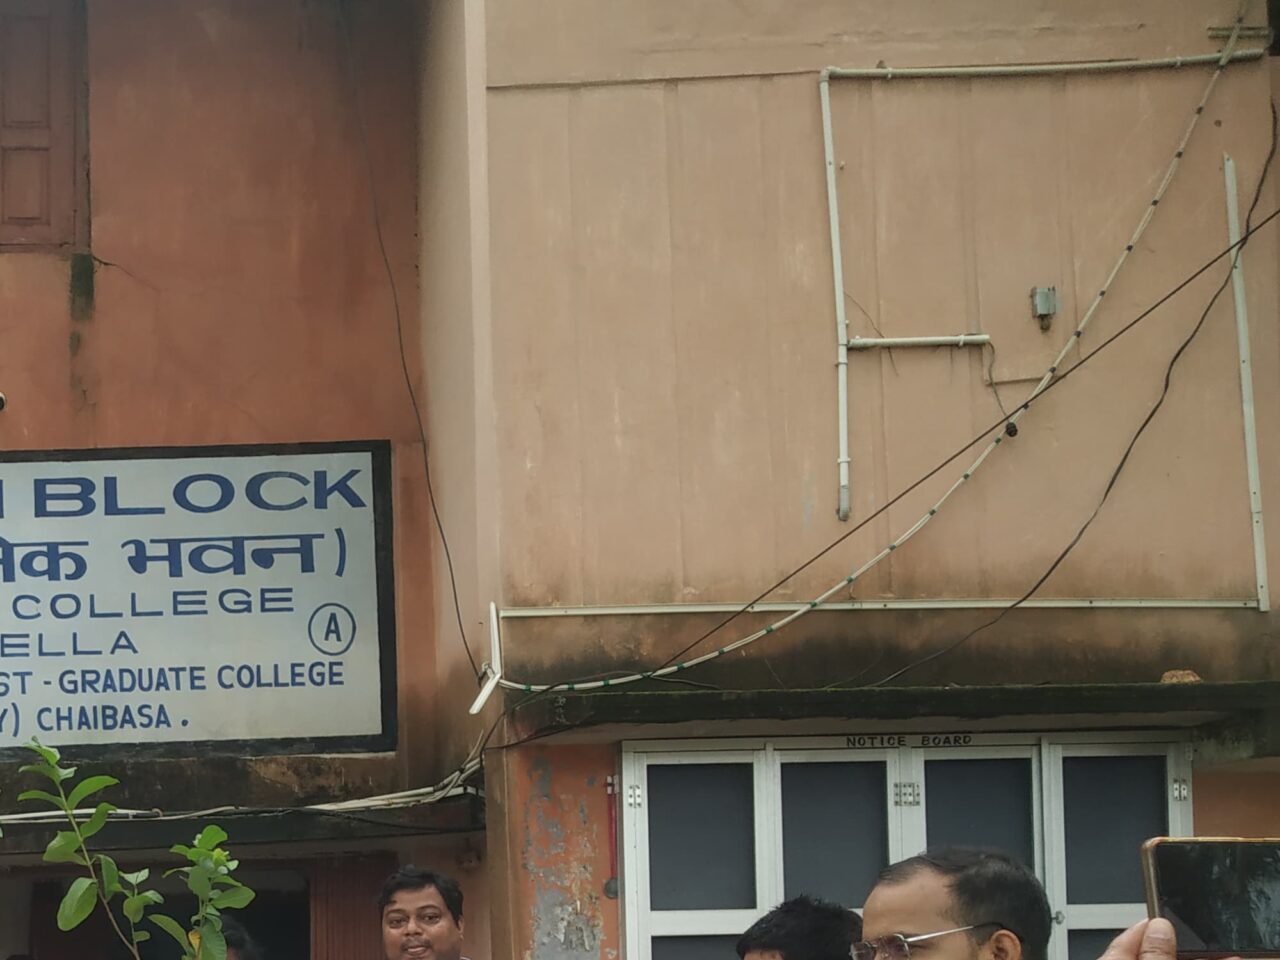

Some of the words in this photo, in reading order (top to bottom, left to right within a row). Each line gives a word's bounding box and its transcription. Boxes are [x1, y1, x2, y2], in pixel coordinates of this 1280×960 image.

[33, 469, 368, 518] BLOCK
[120, 527, 347, 578] भवन)
[12, 588, 295, 621] COLLEGE
[58, 666, 207, 694] GRADUATE
[217, 661, 345, 690] COLLEGE
[846, 736, 907, 748] NOTICE
[921, 735, 972, 746] BOARD
